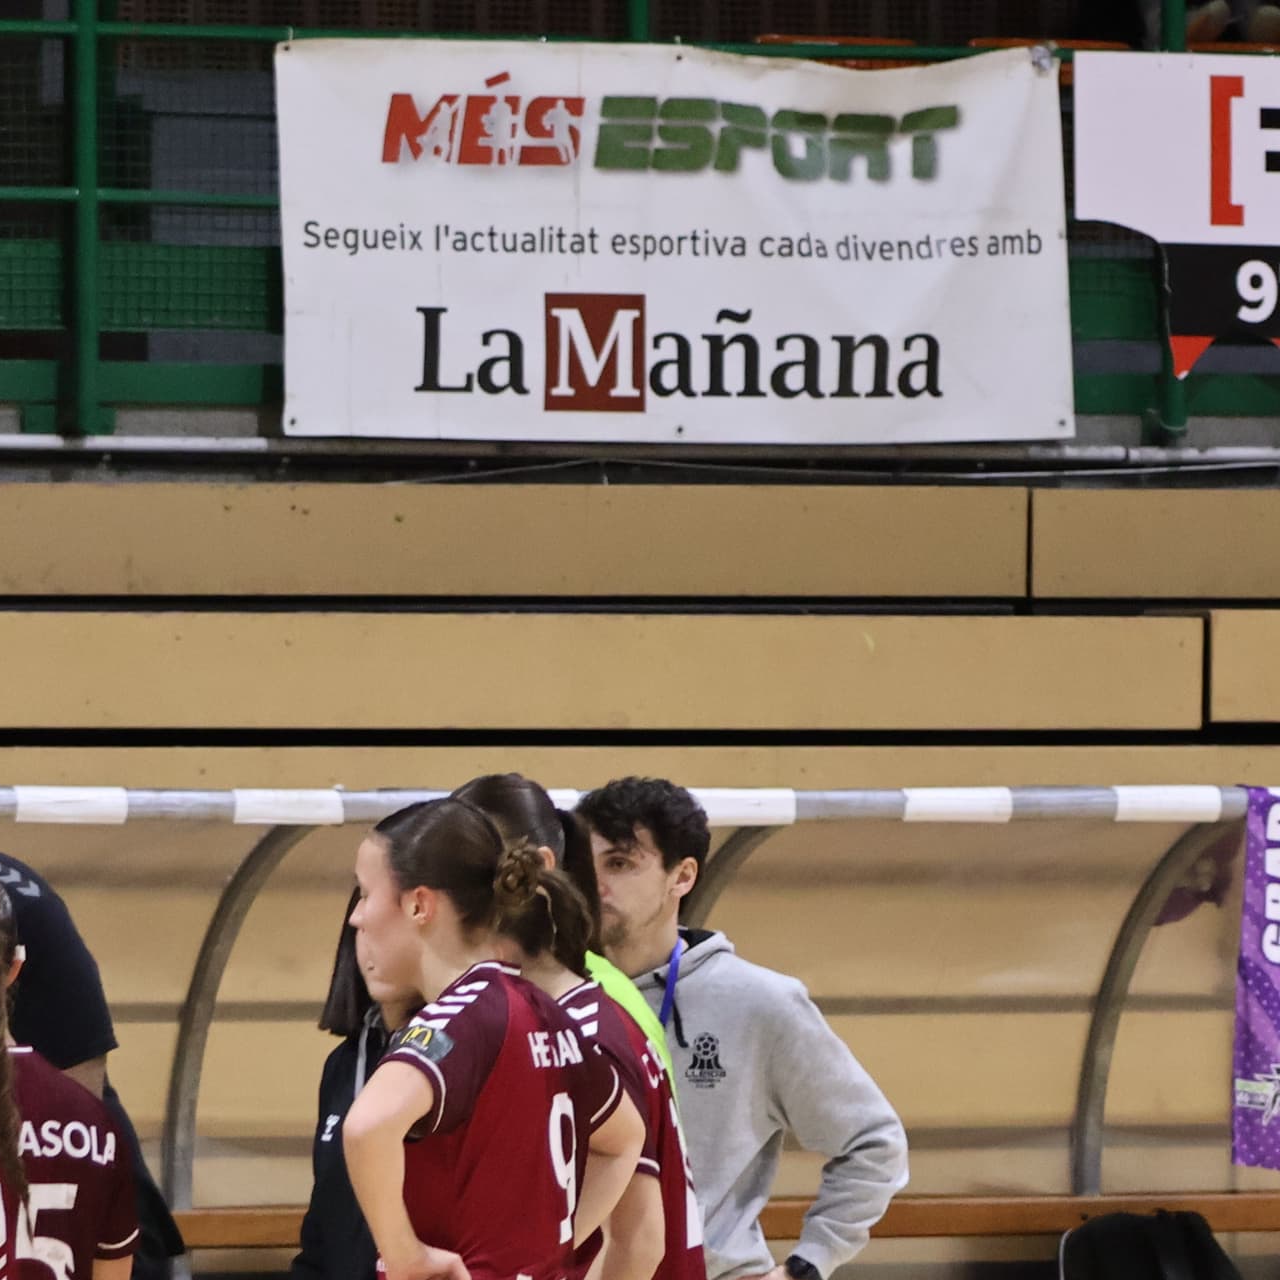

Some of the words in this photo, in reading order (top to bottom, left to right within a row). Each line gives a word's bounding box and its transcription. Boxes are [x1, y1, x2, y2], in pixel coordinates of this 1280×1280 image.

[382, 71, 586, 166] MÉS
[593, 95, 958, 183] ESPORT
[302, 220, 423, 256] Segueix
[434, 224, 600, 254] l'actualitat
[611, 228, 747, 261] esportiva
[758, 232, 828, 259] cada
[836, 233, 979, 262] divendres
[987, 228, 1042, 257] amb
[548, 1093, 577, 1244] 9
